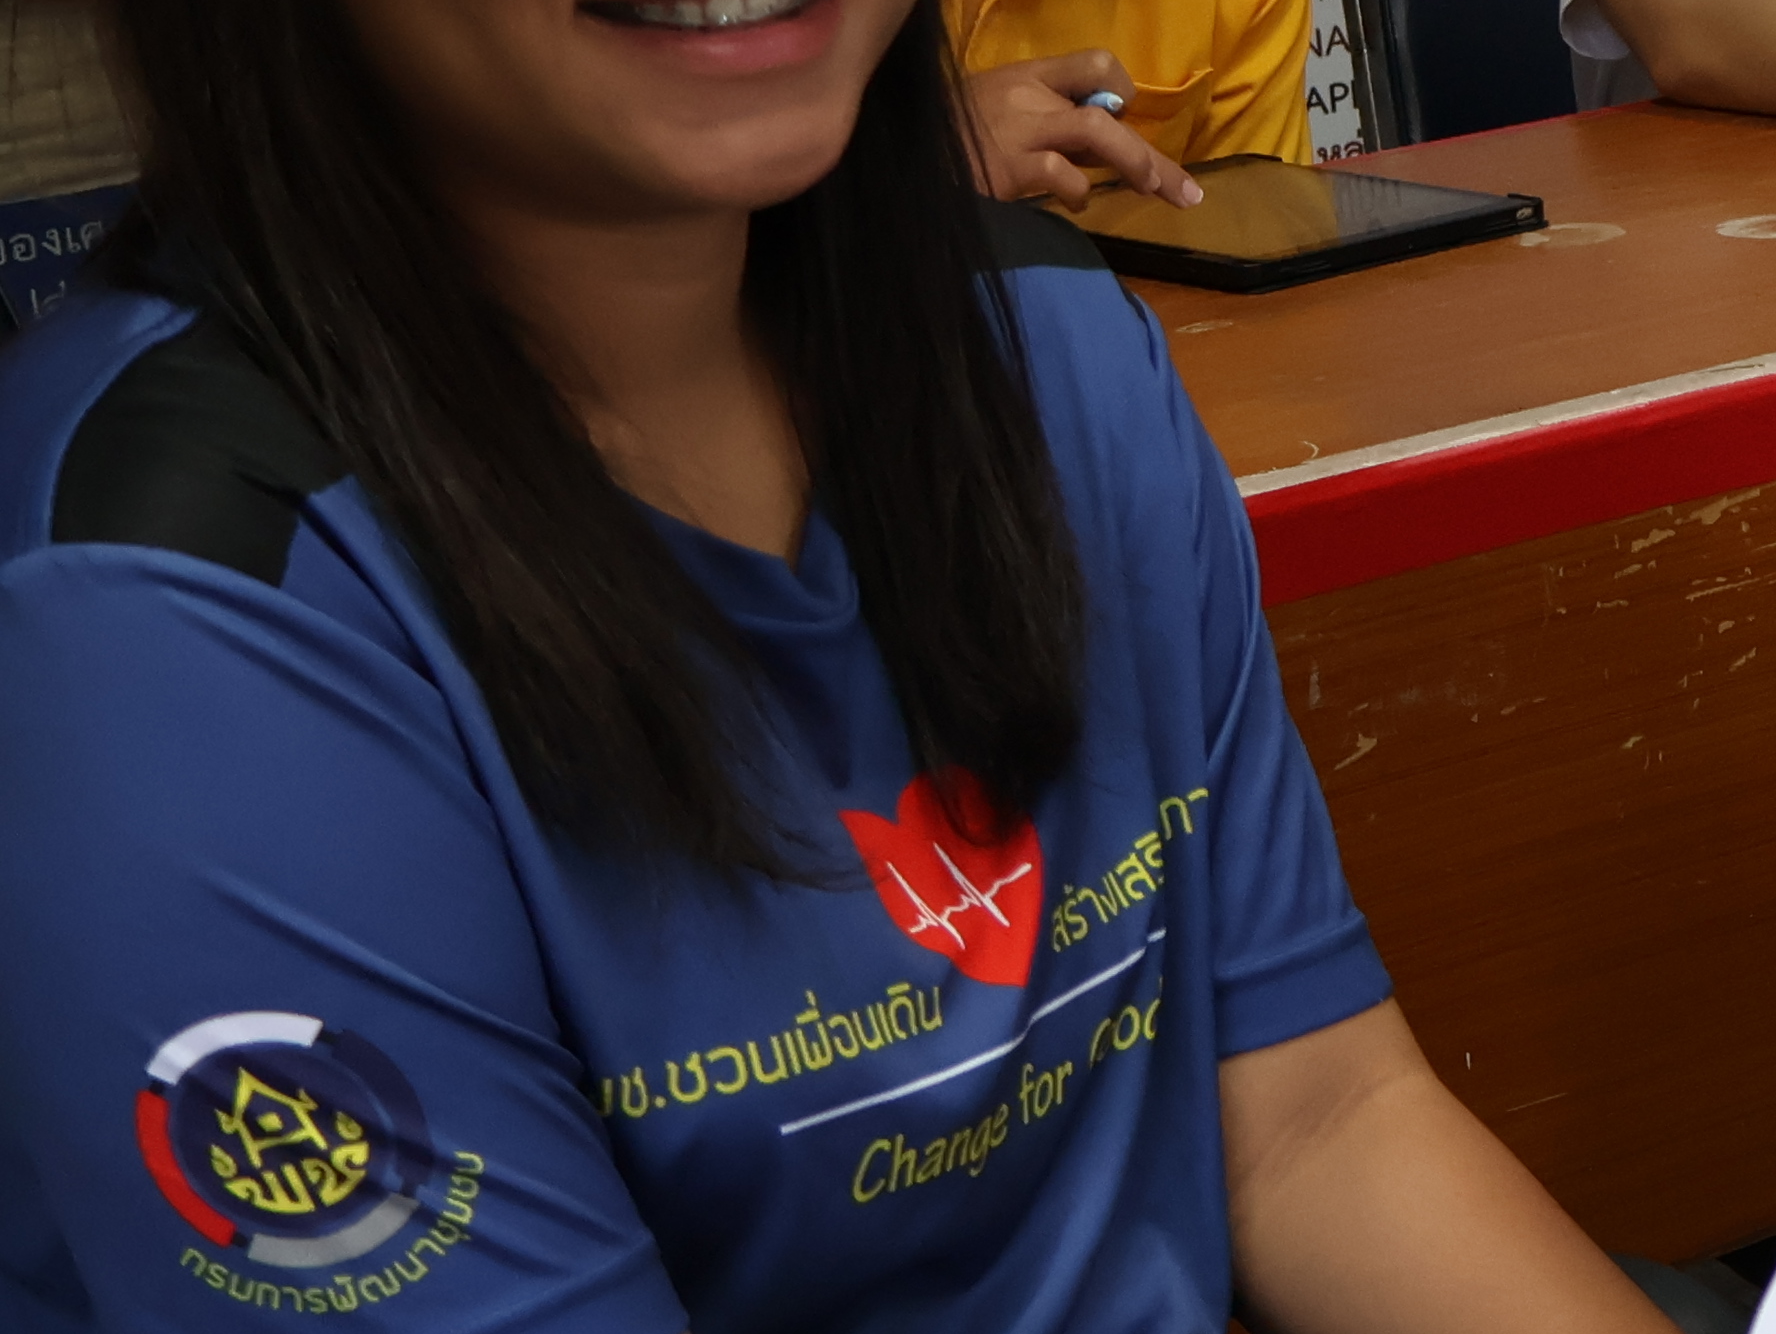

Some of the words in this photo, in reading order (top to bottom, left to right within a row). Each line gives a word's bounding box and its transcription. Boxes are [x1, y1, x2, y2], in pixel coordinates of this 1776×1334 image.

[851, 1102, 1009, 1204] Change
[1019, 1061, 1074, 1126] for
[179, 1150, 485, 1315] กรมการพัฒนาชุมชน
